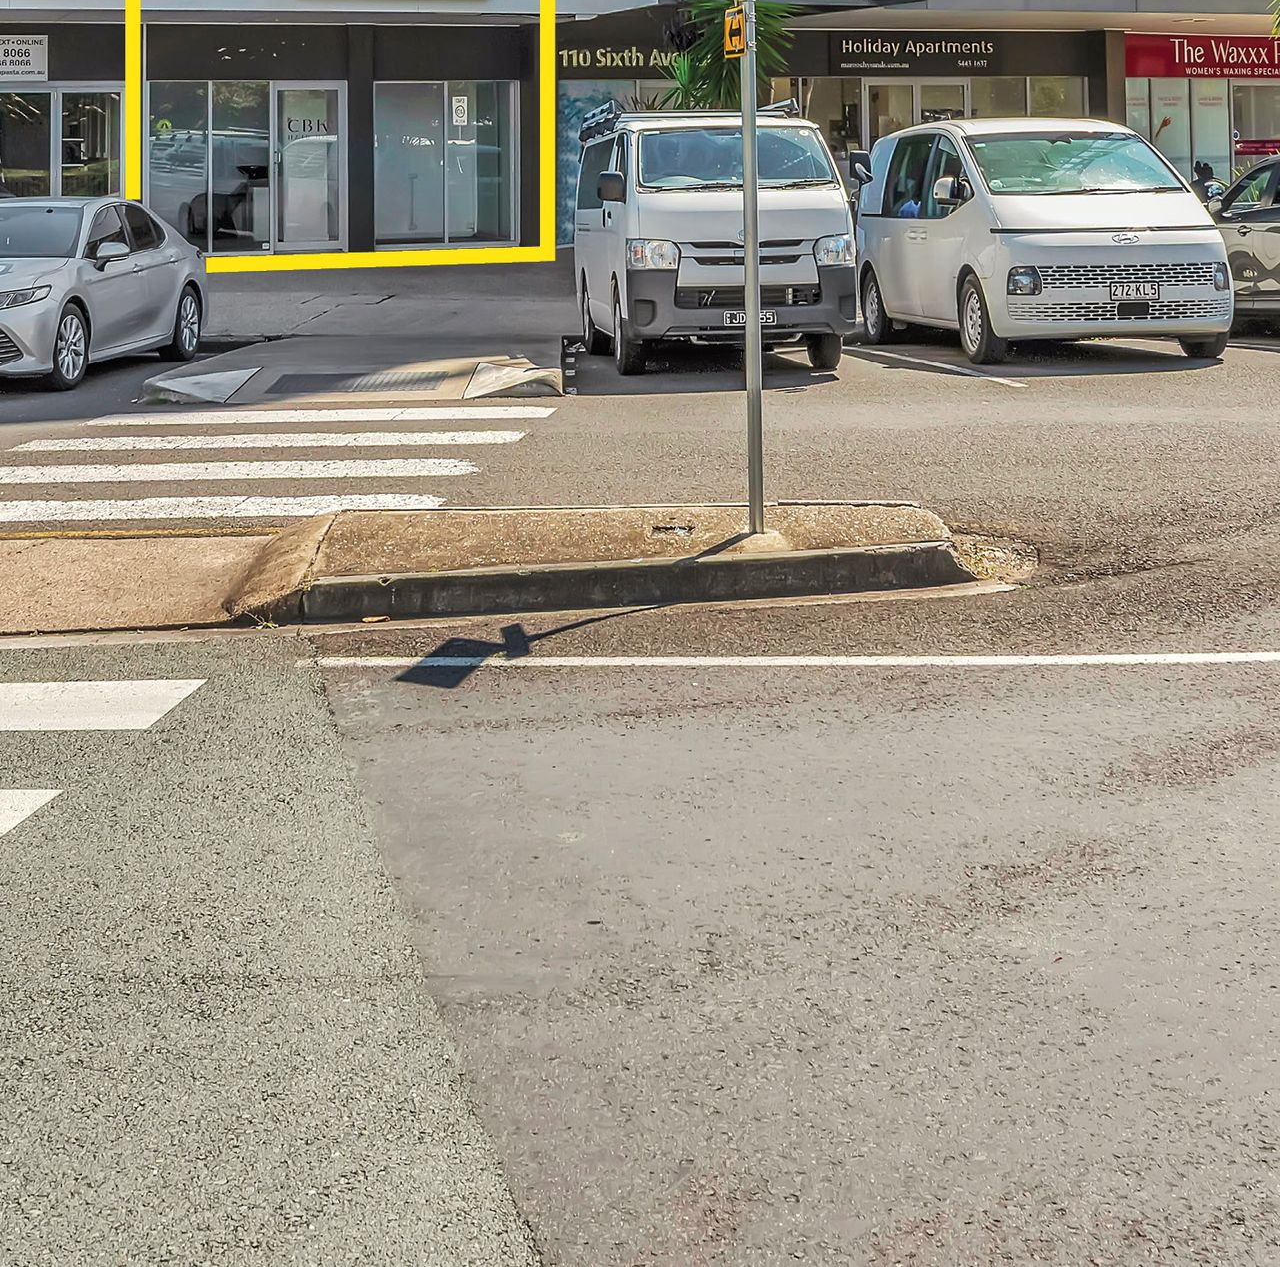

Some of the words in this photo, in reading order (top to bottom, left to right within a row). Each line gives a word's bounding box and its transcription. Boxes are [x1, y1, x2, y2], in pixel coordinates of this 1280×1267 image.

[3, 48, 31, 57] 8066
[842, 38, 900, 56] Holiday
[905, 39, 994, 57] Apartments
[1170, 38, 1206, 63] The
[1211, 39, 1269, 64] Waxxx
[559, 49, 591, 68] 110
[596, 46, 644, 68] Sixth
[957, 60, 972, 68] 5443
[1185, 67, 1221, 76] WOMEN'S
[1223, 67, 1252, 76] WAXING
[288, 118, 328, 133] CBK
